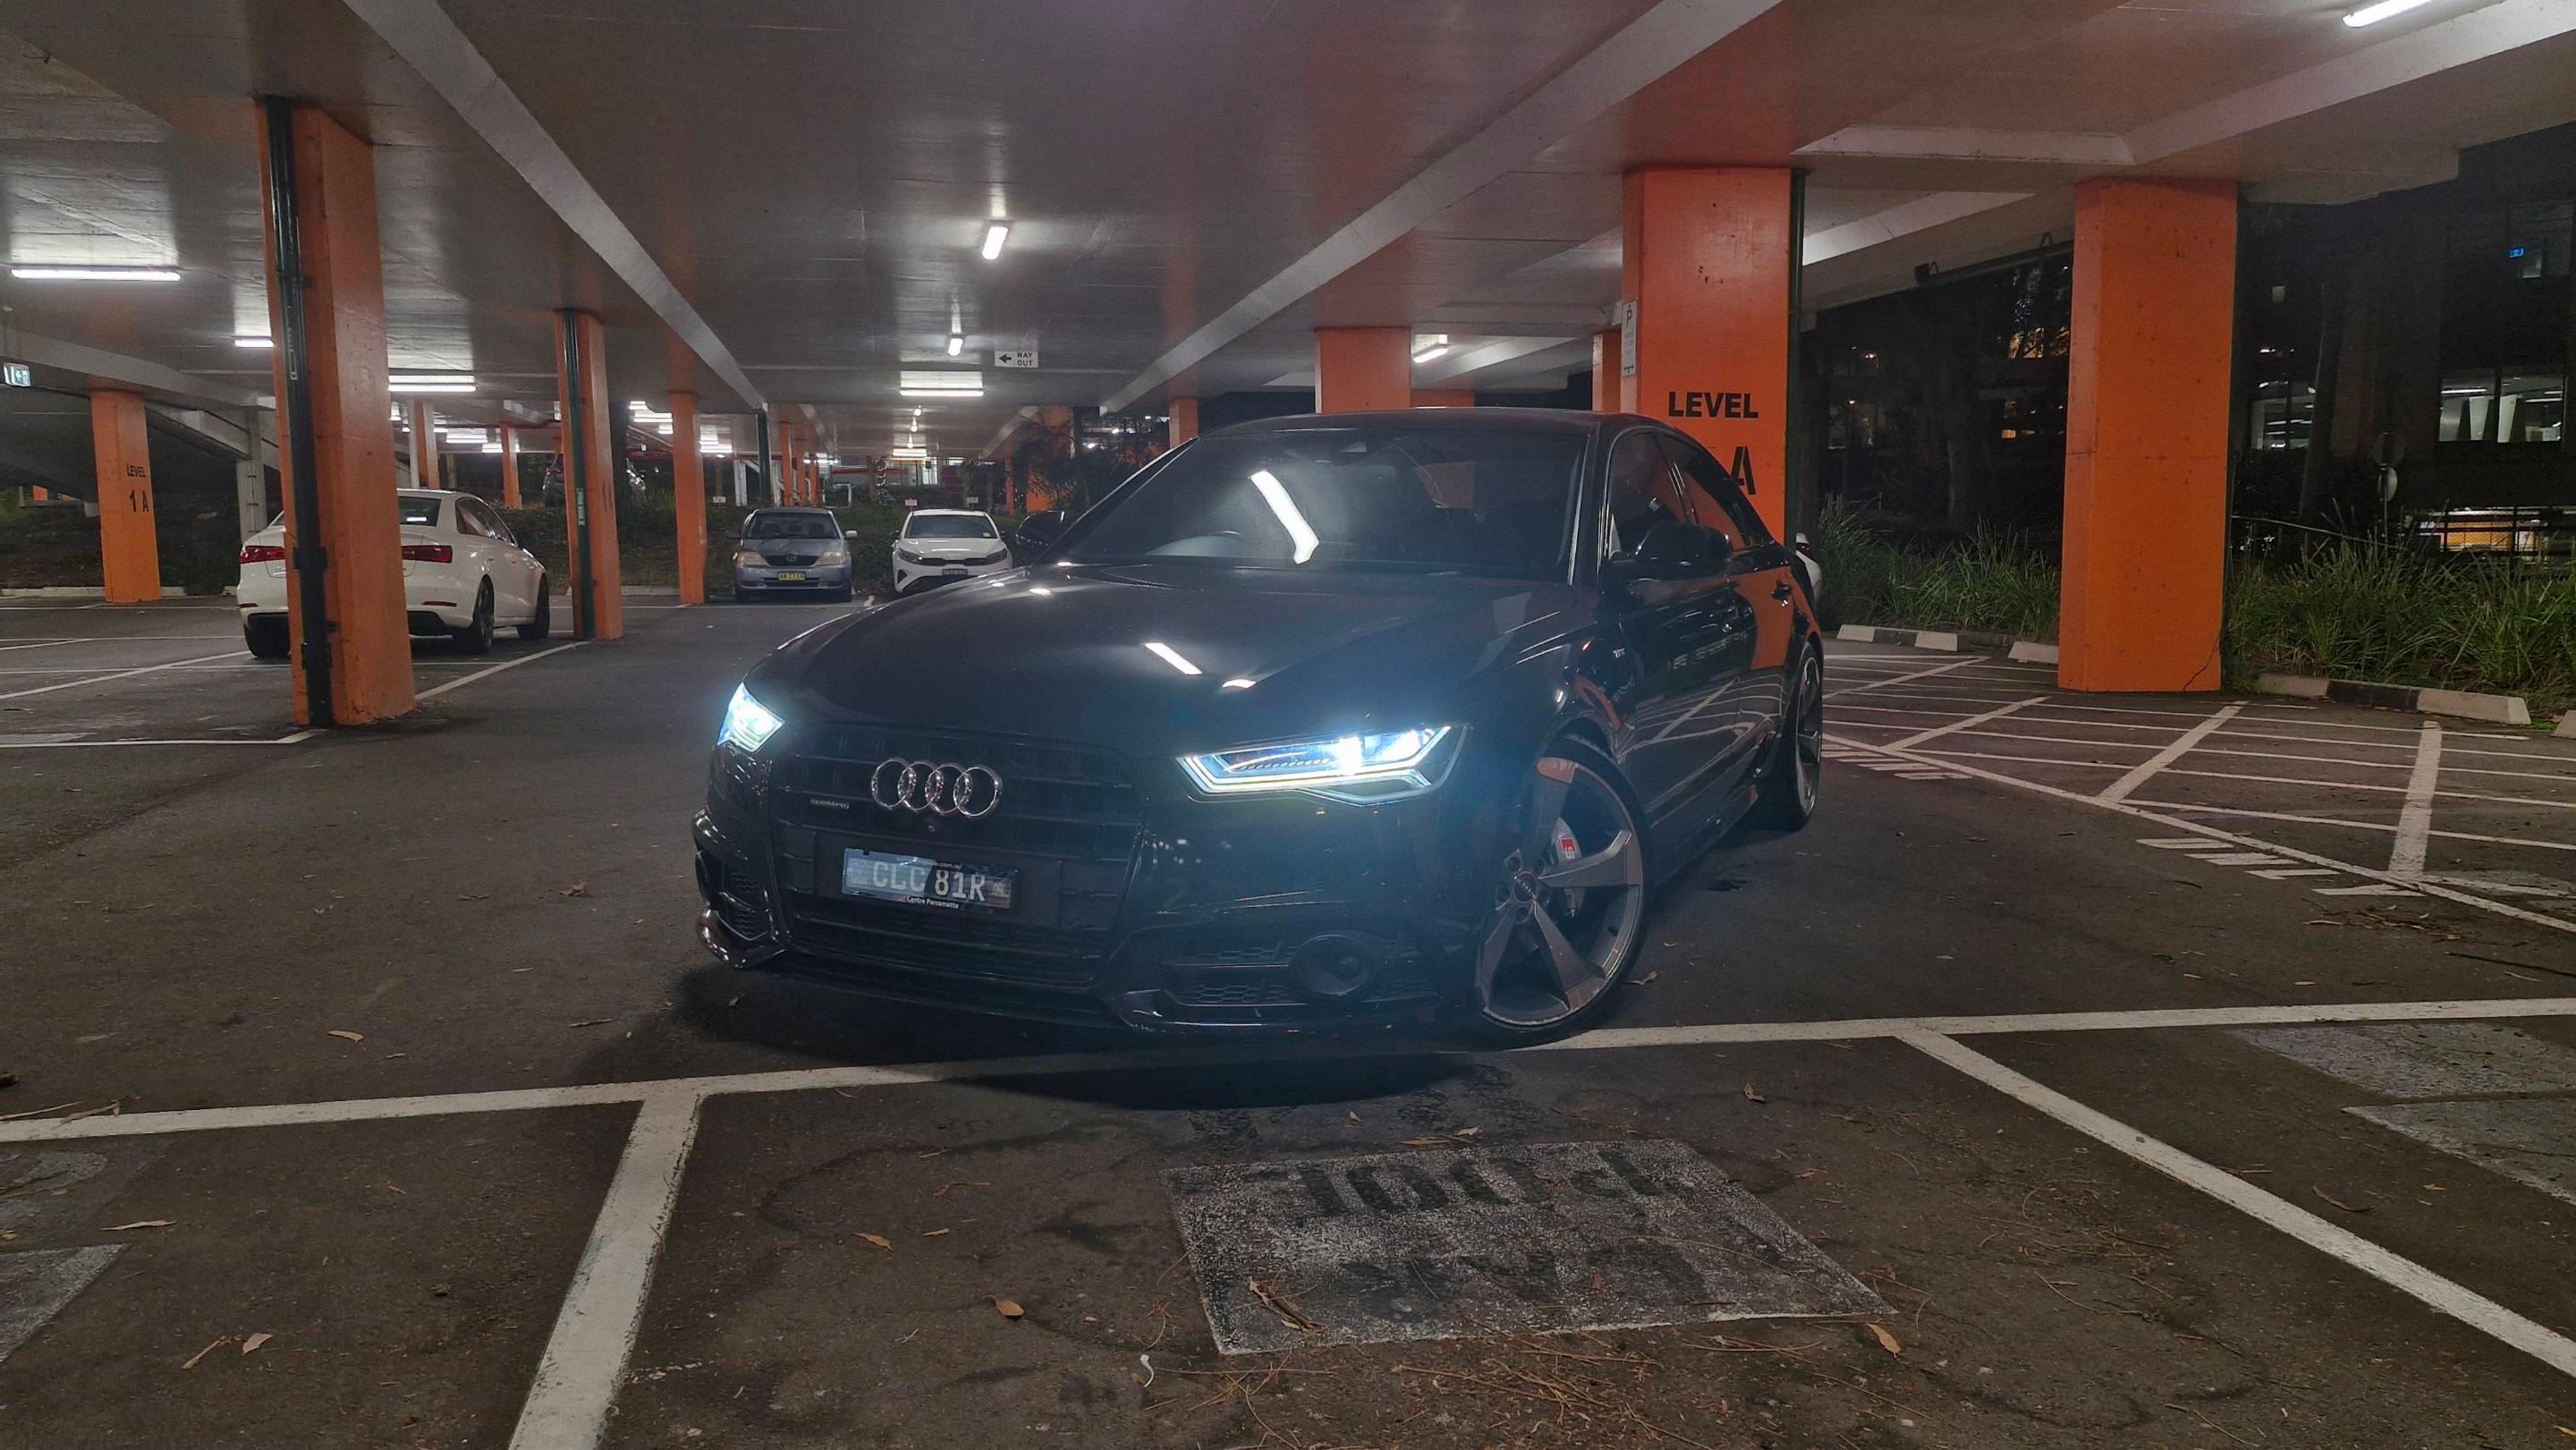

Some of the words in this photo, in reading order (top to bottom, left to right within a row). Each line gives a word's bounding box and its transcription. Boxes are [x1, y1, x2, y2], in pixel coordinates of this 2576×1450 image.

[1668, 391, 1759, 419] LEVEL
[1729, 445, 1757, 496] A
[872, 861, 926, 893] CLC
[934, 869, 986, 902] 81R
